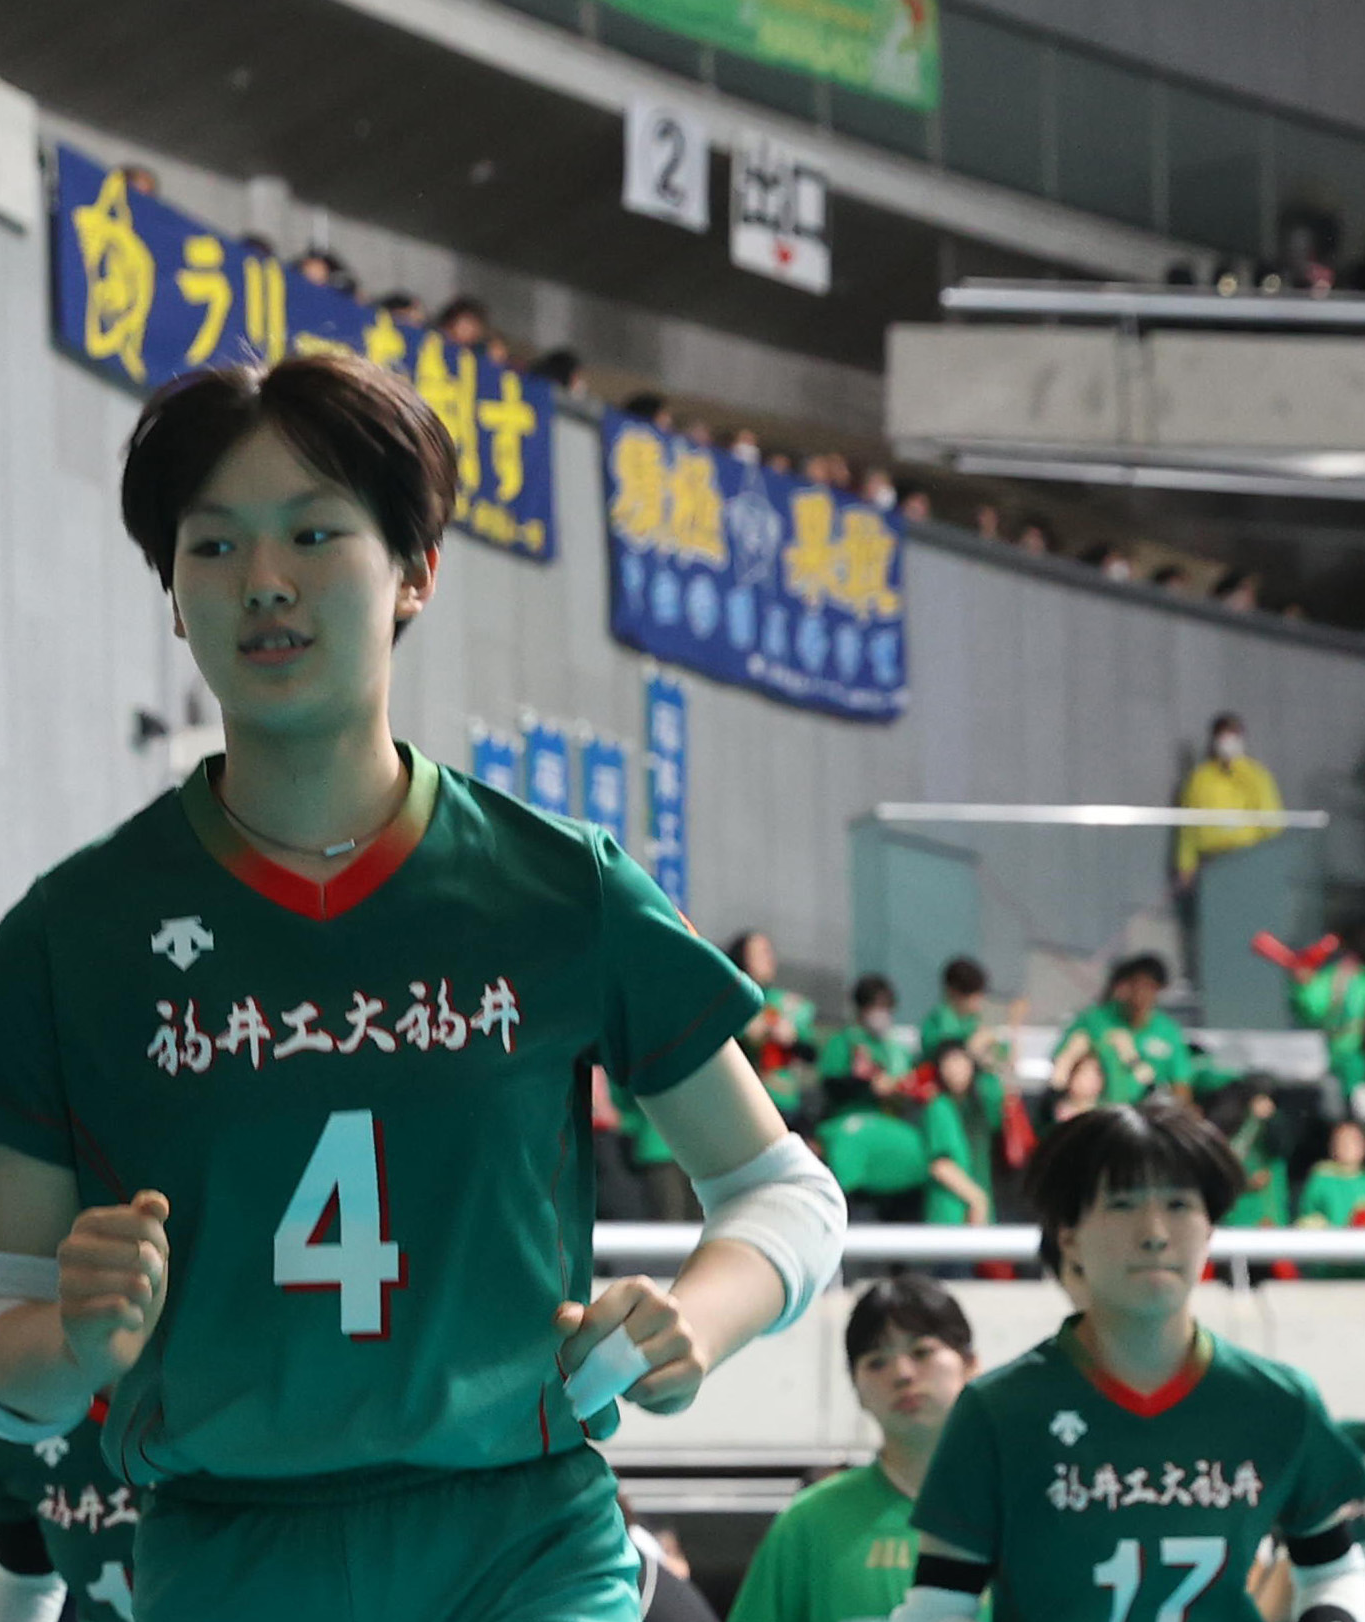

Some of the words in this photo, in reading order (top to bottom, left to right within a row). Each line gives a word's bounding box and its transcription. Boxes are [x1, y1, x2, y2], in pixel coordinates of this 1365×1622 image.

[654, 116, 689, 209] 2
[146, 975, 523, 1077] 福井工大福井
[272, 1108, 409, 1342] 4
